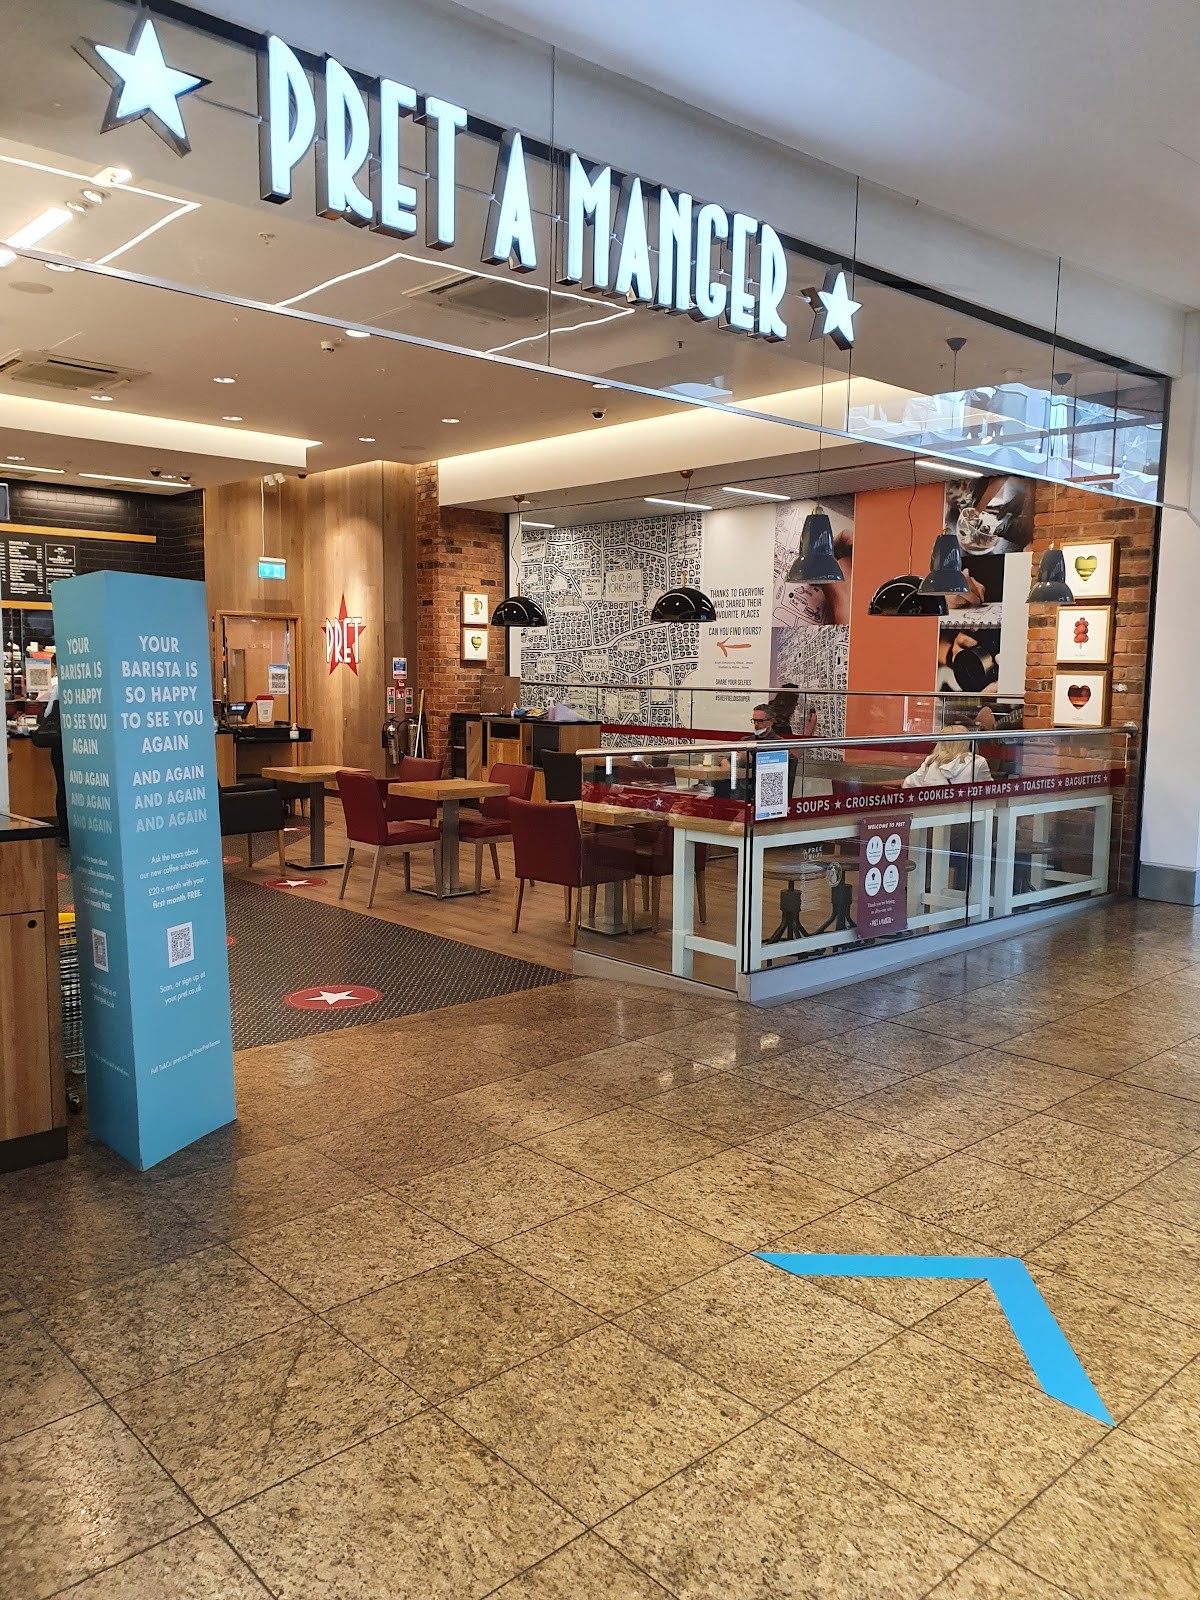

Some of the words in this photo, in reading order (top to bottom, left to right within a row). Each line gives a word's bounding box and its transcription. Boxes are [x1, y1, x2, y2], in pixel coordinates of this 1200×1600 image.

[259, 34, 467, 250] PRET
[482, 128, 538, 273] A
[556, 151, 788, 343] MANGER
[608, 581, 640, 593] YORKSHIRE
[710, 589, 729, 598] THANKS
[731, 588, 737, 597] TO
[738, 587, 764, 597] EVERYONE
[726, 599, 745, 608] SHARED
[747, 598, 761, 607] THEIR
[741, 609, 759, 618] PLACES
[325, 616, 362, 664] PRET
[709, 627, 718, 636] CAN
[719, 627, 729, 635] YOU
[730, 626, 742, 635] FIND
[742, 626, 761, 635] YOURS?
[66, 636, 90, 655] YOUR
[138, 635, 179, 653] YOUR
[60, 662, 92, 680] BARISTA
[93, 661, 102, 679] IS
[121, 660, 182, 678] BARISTA
[186, 661, 198, 678] IS
[63, 688, 73, 705] SO
[75, 687, 103, 705] HAPPY
[125, 686, 146, 704] SO
[151, 686, 198, 703] HAPPY
[61, 713, 72, 730] TO
[73, 713, 87, 730] SEE
[87, 713, 107, 730] YOU
[120, 712, 142, 730] TO
[146, 711, 170, 729] SEE
[173, 709, 204, 727] YOU
[72, 738, 98, 755] AGAIN
[142, 734, 189, 754] AGAIN
[69, 770, 83, 785] AND
[85, 771, 110, 787] AGAIN
[132, 770, 161, 787] AND
[165, 765, 205, 782] AGAIN
[71, 792, 85, 807] AND
[86, 795, 111, 811] AGAIN
[134, 792, 163, 810] AND
[167, 786, 207, 805] AGAIN
[796, 799, 830, 814] SOUPS
[845, 793, 904, 809] CROISSANTS
[918, 788, 955, 802] COOKIES
[985, 783, 1011, 795] WRAPS
[1022, 778, 1055, 791] TOASTIES
[1065, 774, 1102, 787] BAGUETTES
[136, 815, 164, 833] AND
[168, 808, 208, 828] AGAIN
[151, 854, 161, 864] Ask
[162, 853, 170, 861] the
[171, 852, 184, 860] team
[184, 848, 199, 857] about
[808, 846, 823, 854] FREE
[139, 872, 150, 880] our
[150, 869, 162, 878] new
[163, 864, 179, 875] coffee
[148, 886, 160, 896] £20
[165, 881, 181, 892] month
[182, 878, 193, 888] with
[193, 877, 205, 888] your
[152, 899, 165, 909] first
[166, 893, 187, 906] month
[187, 889, 203, 900] FREE.
[159, 985, 174, 994] Scan,
[175, 980, 181, 988] or
[182, 977, 192, 987] sign
[193, 974, 200, 983] up
